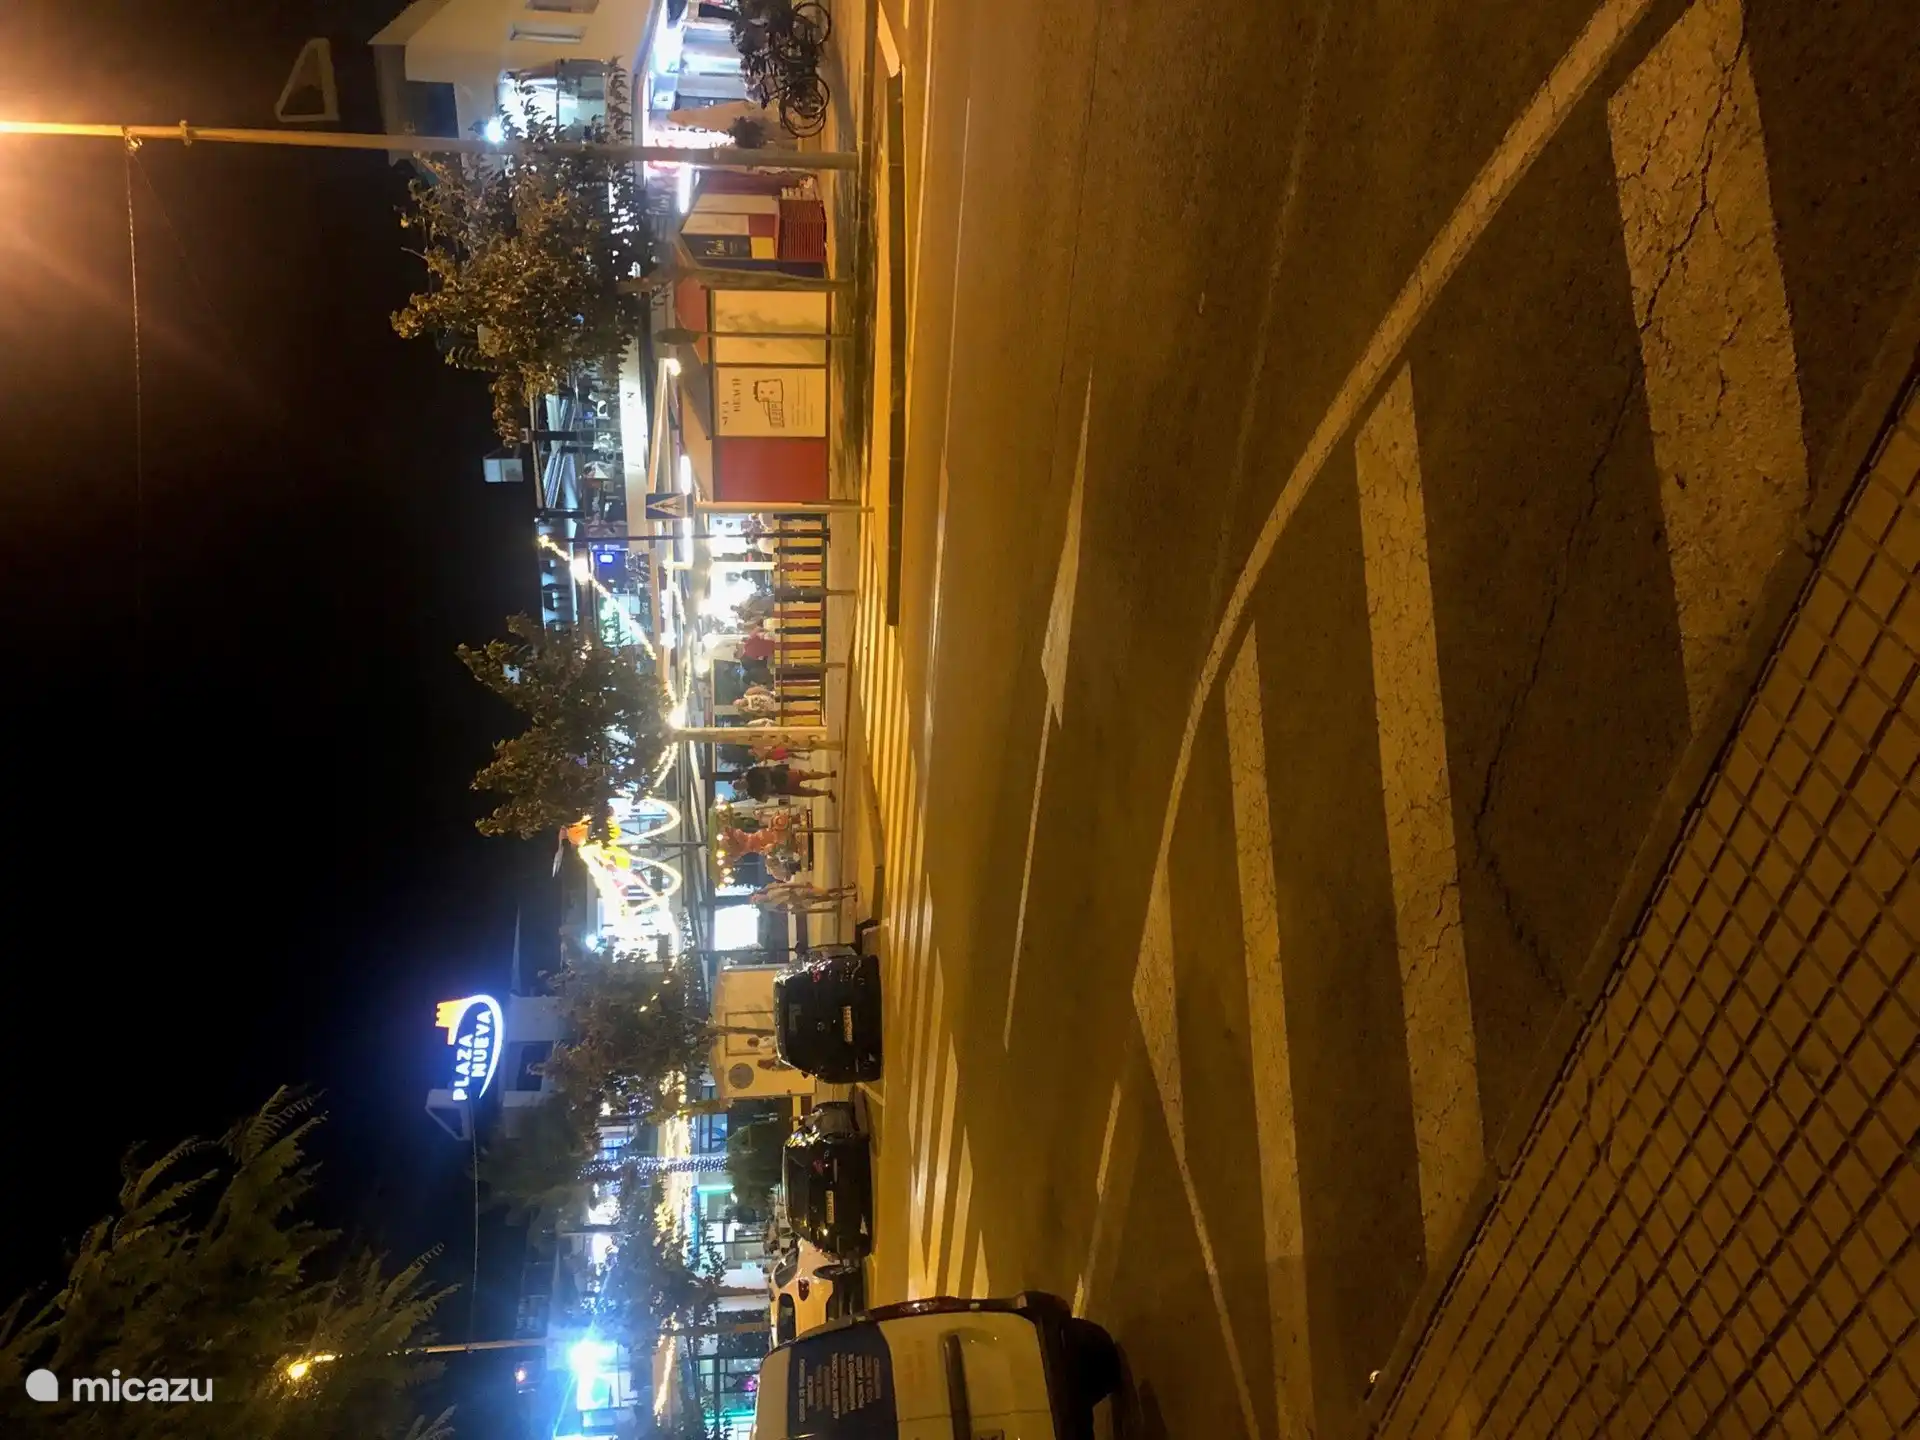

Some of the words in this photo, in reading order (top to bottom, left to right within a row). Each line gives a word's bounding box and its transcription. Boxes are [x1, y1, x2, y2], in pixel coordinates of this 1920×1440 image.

[732, 378, 742, 412] BEACH
[452, 1034, 474, 1101] PLAZA
[472, 1010, 492, 1078] NUEVA
